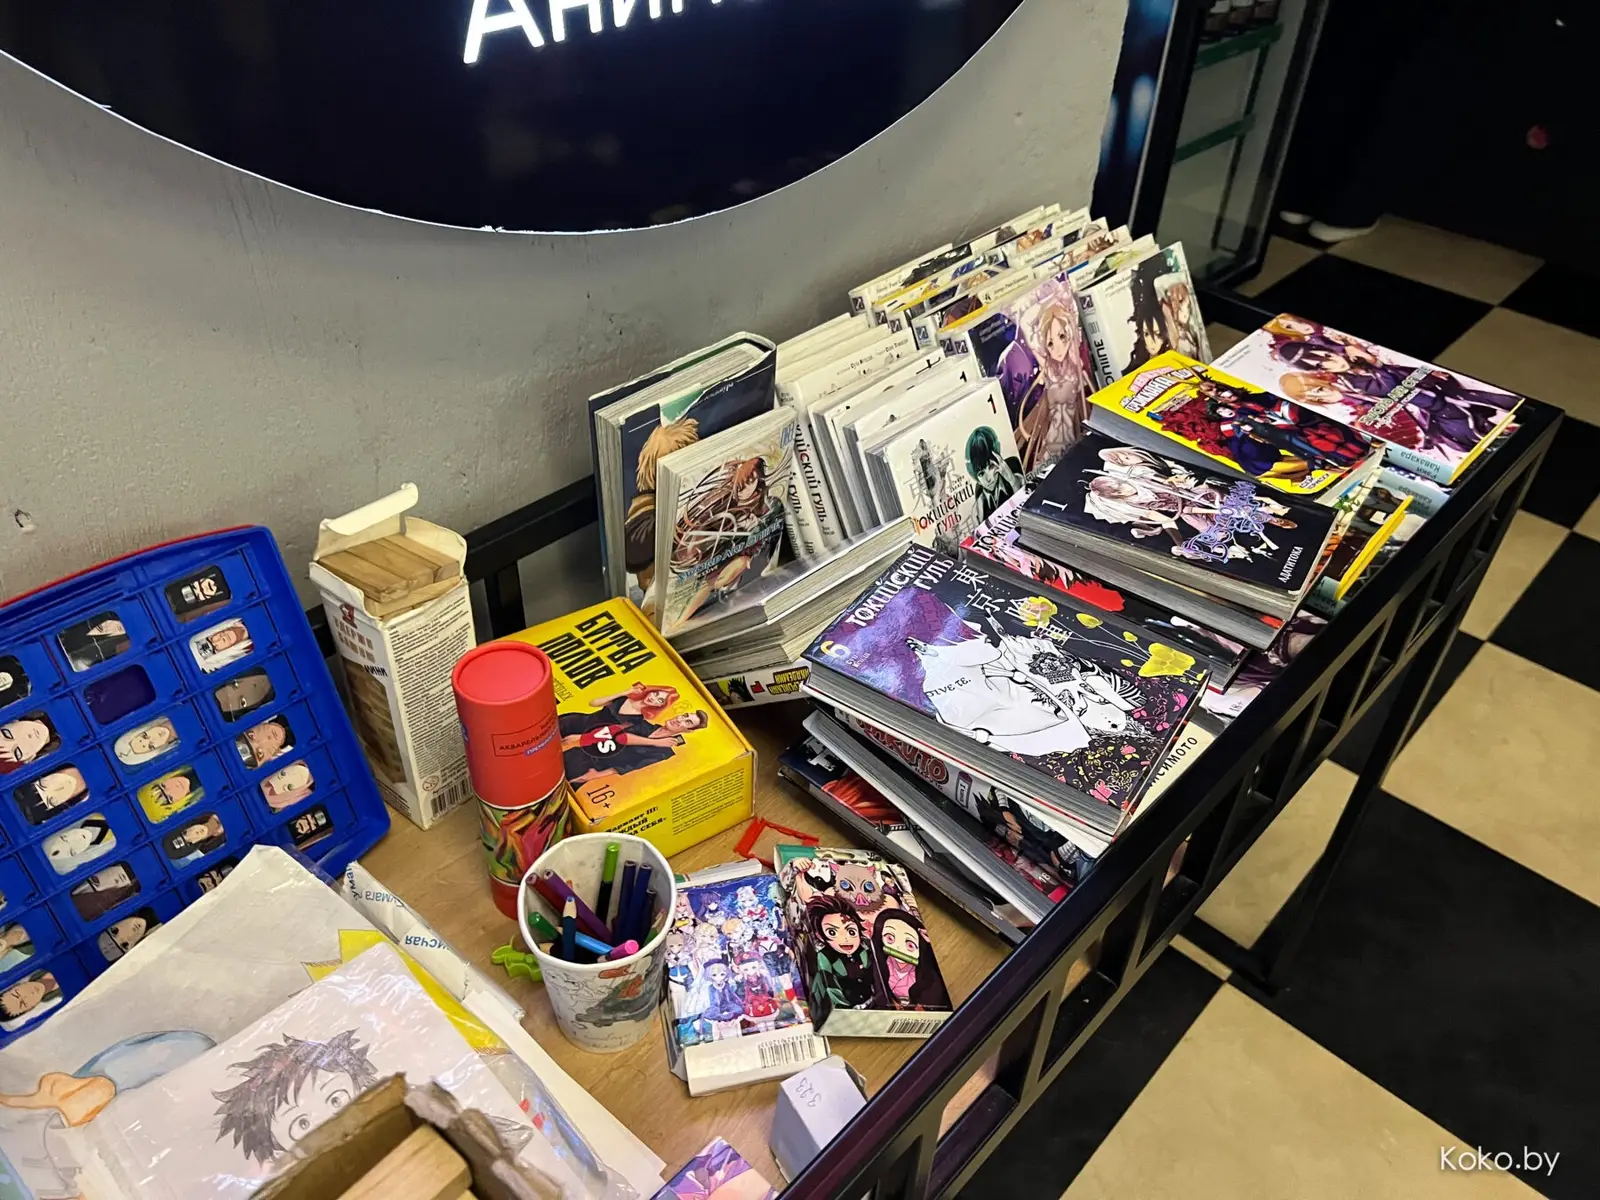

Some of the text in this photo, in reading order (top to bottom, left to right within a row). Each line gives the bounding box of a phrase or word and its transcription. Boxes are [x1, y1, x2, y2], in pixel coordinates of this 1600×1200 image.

[986, 393, 997, 415] 1
[845, 547, 936, 627] ТОКИЙСКИЙ
[913, 559, 954, 591] ГУЛЬ
[573, 610, 657, 675] БИТВА
[820, 640, 850, 659] 6
[535, 631, 616, 690] ПОЛОВ
[593, 725, 618, 755] VS
[586, 783, 616, 809] 16+
